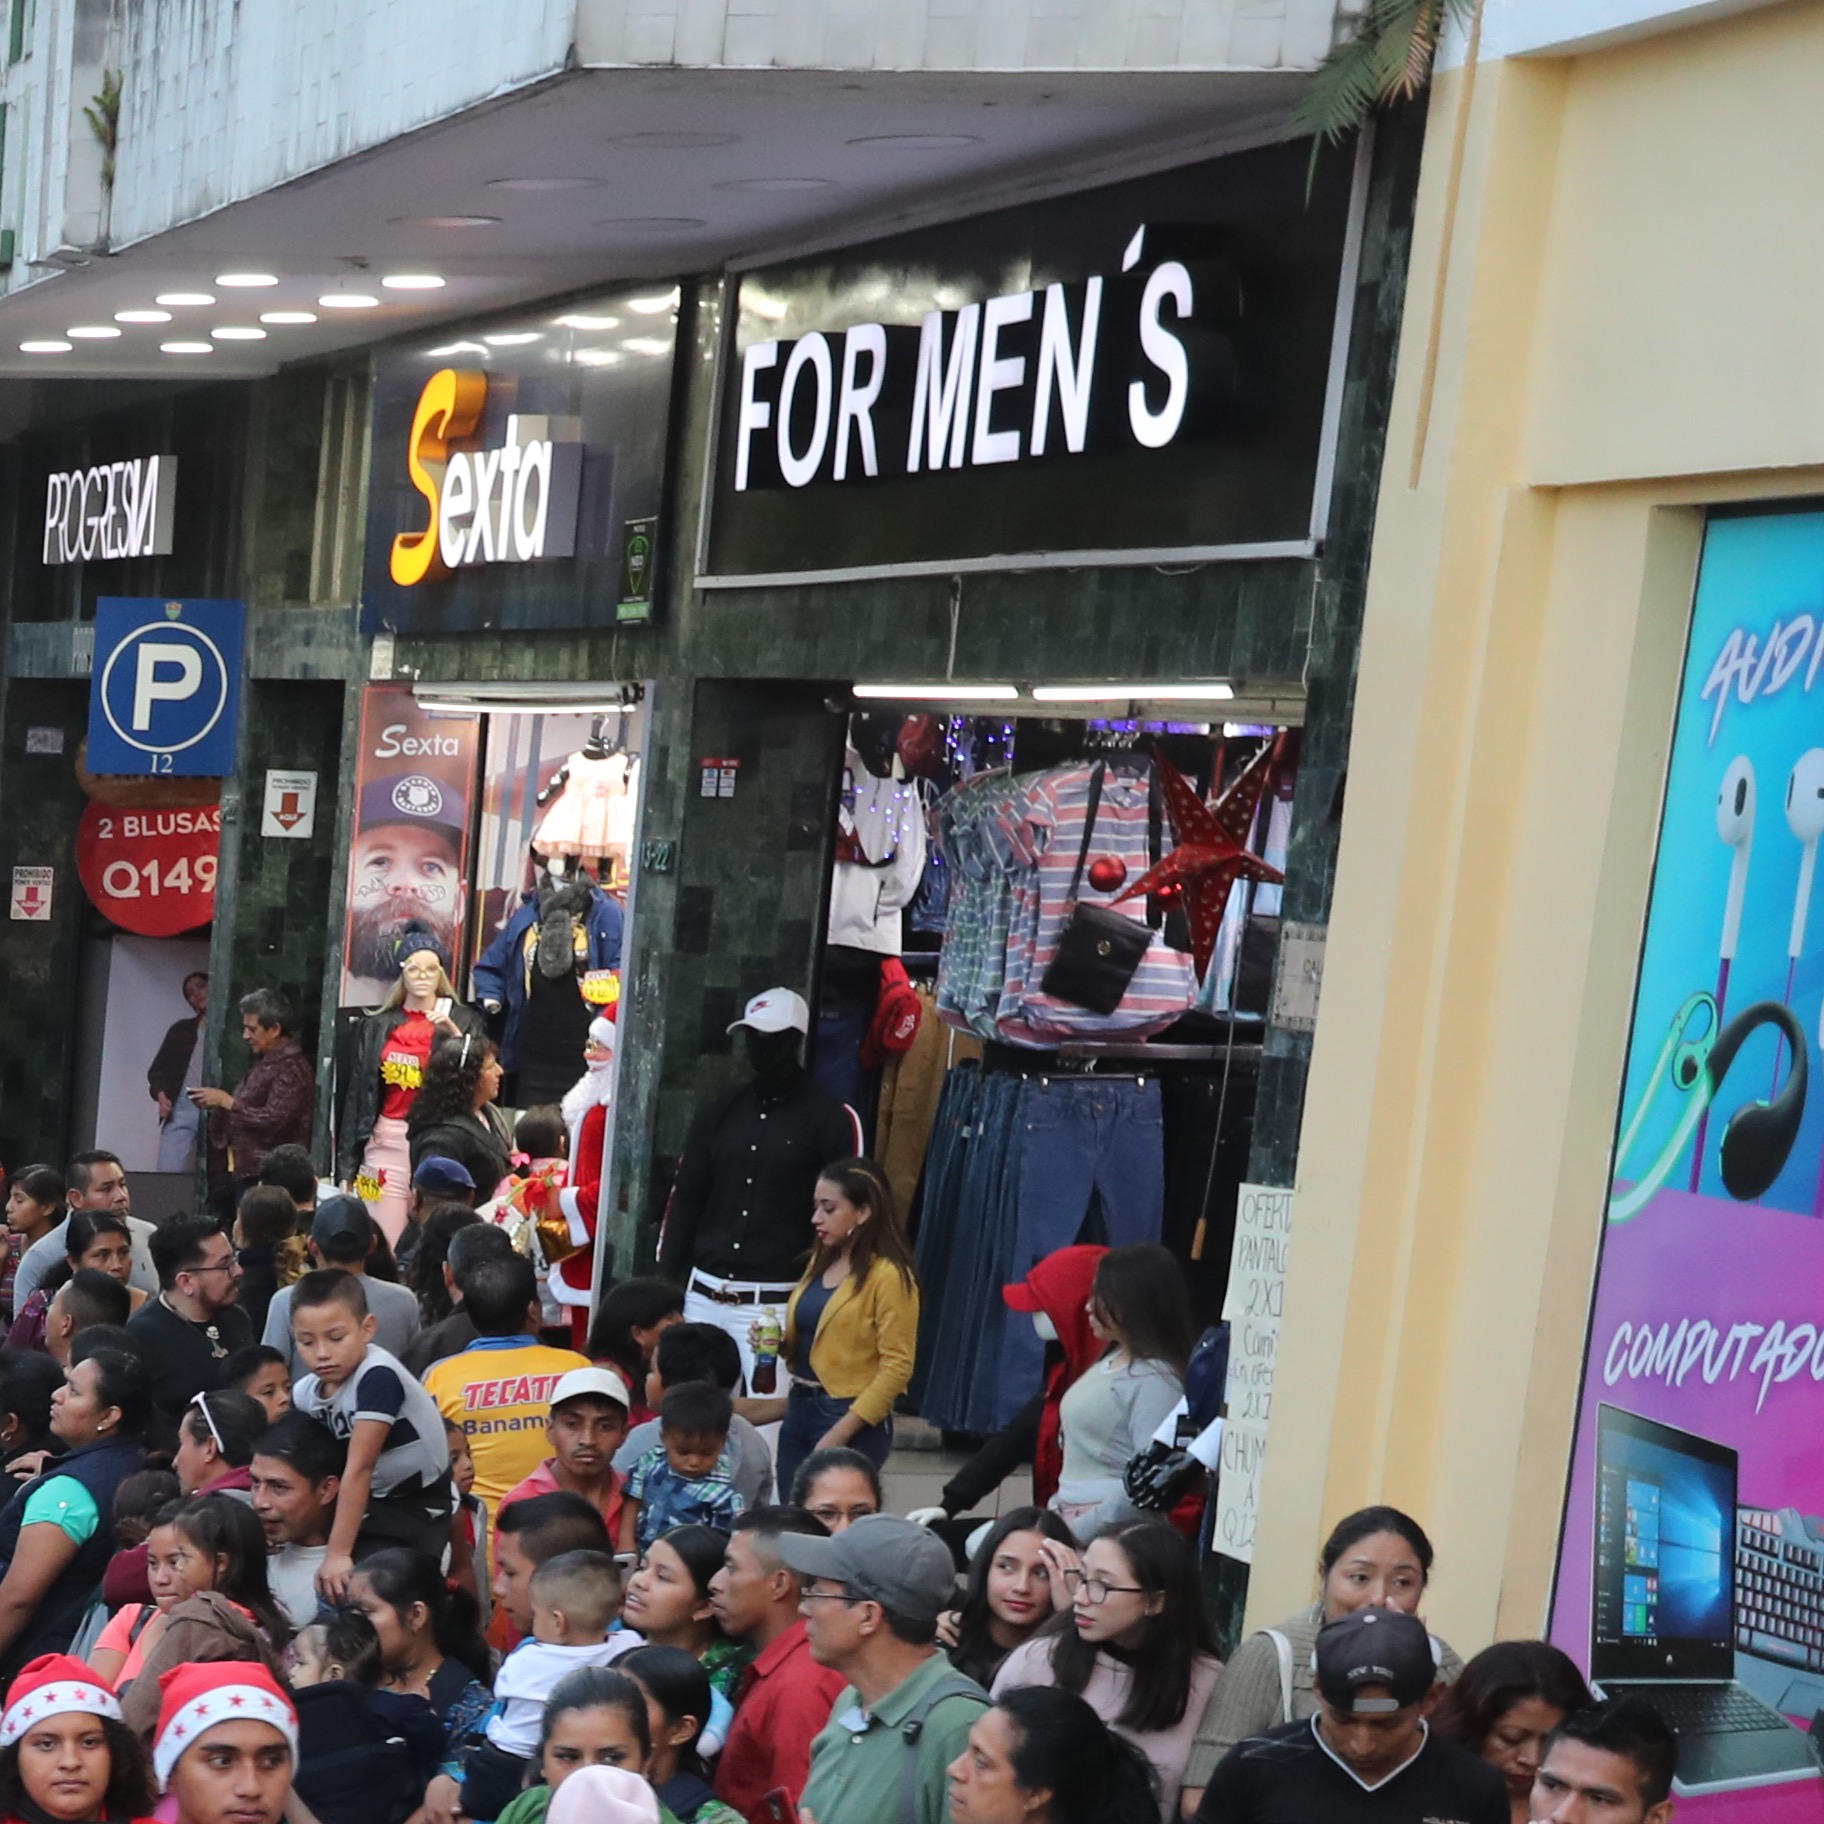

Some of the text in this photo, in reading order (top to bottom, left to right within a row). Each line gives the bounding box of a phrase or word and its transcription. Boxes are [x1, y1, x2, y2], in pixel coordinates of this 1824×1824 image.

[734, 323, 887, 492] FOR
[389, 368, 553, 588] Sexta
[132, 643, 203, 731] P
[374, 724, 460, 758] Sexta
[151, 754, 174, 773] 12
[98, 809, 220, 839] 2 BLUSAS
[14, 868, 52, 879] PROHIBIDO
[102, 854, 219, 899] Q149
[463, 1415, 550, 1436] Banam
